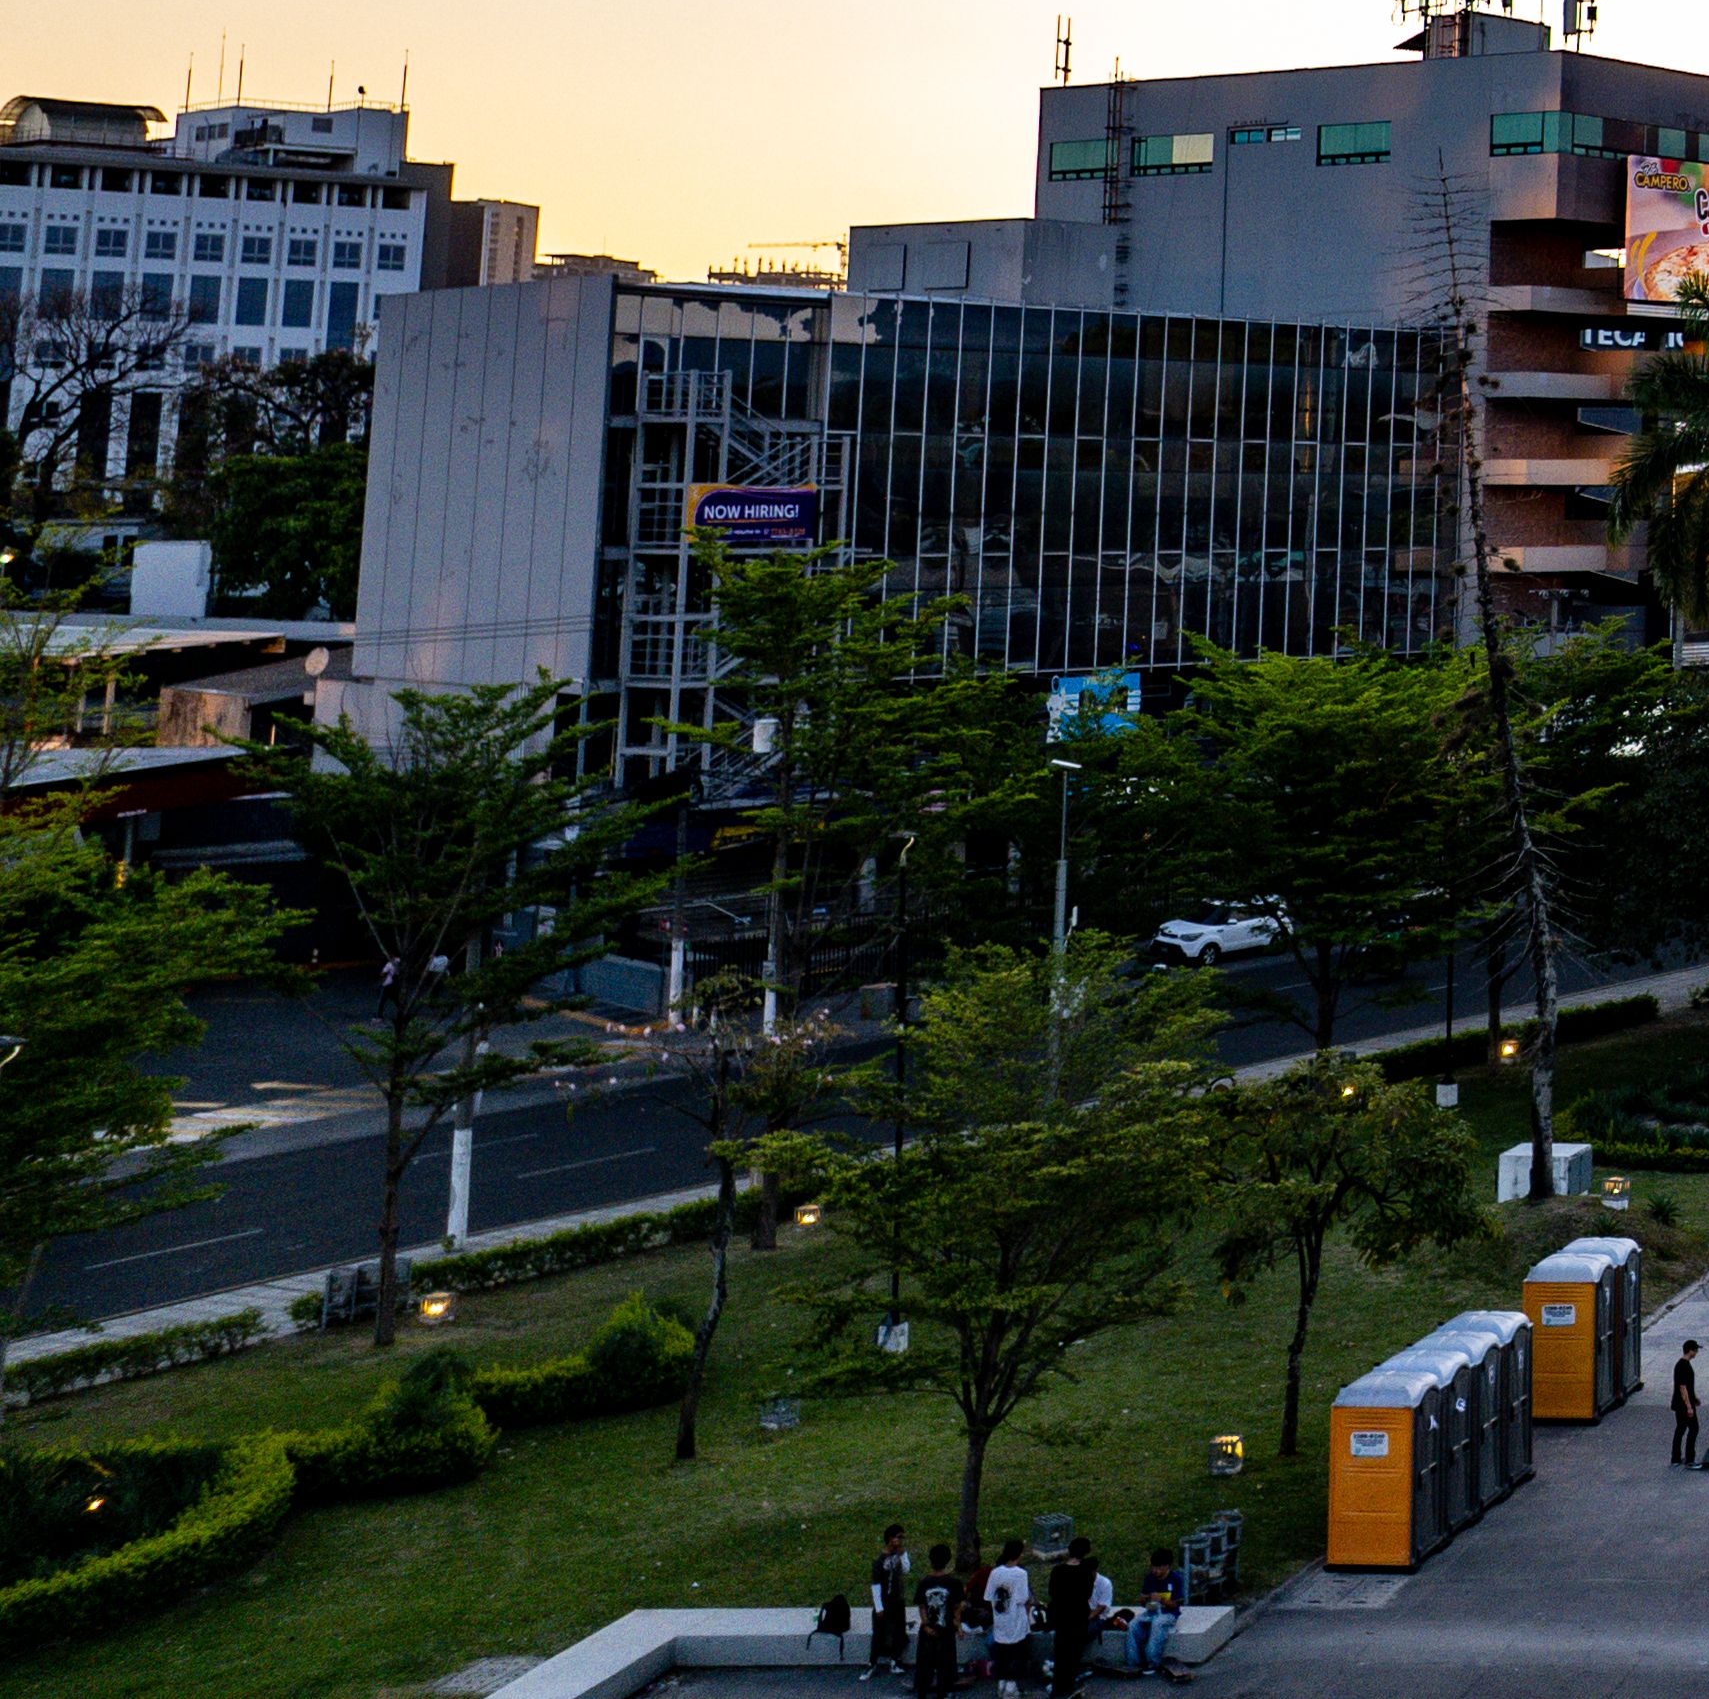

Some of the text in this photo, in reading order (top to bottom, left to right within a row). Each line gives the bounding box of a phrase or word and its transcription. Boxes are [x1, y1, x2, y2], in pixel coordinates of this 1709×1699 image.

[1635, 172, 1688, 191] CAMPERO
[704, 504, 799, 519] NOW HIRING!
